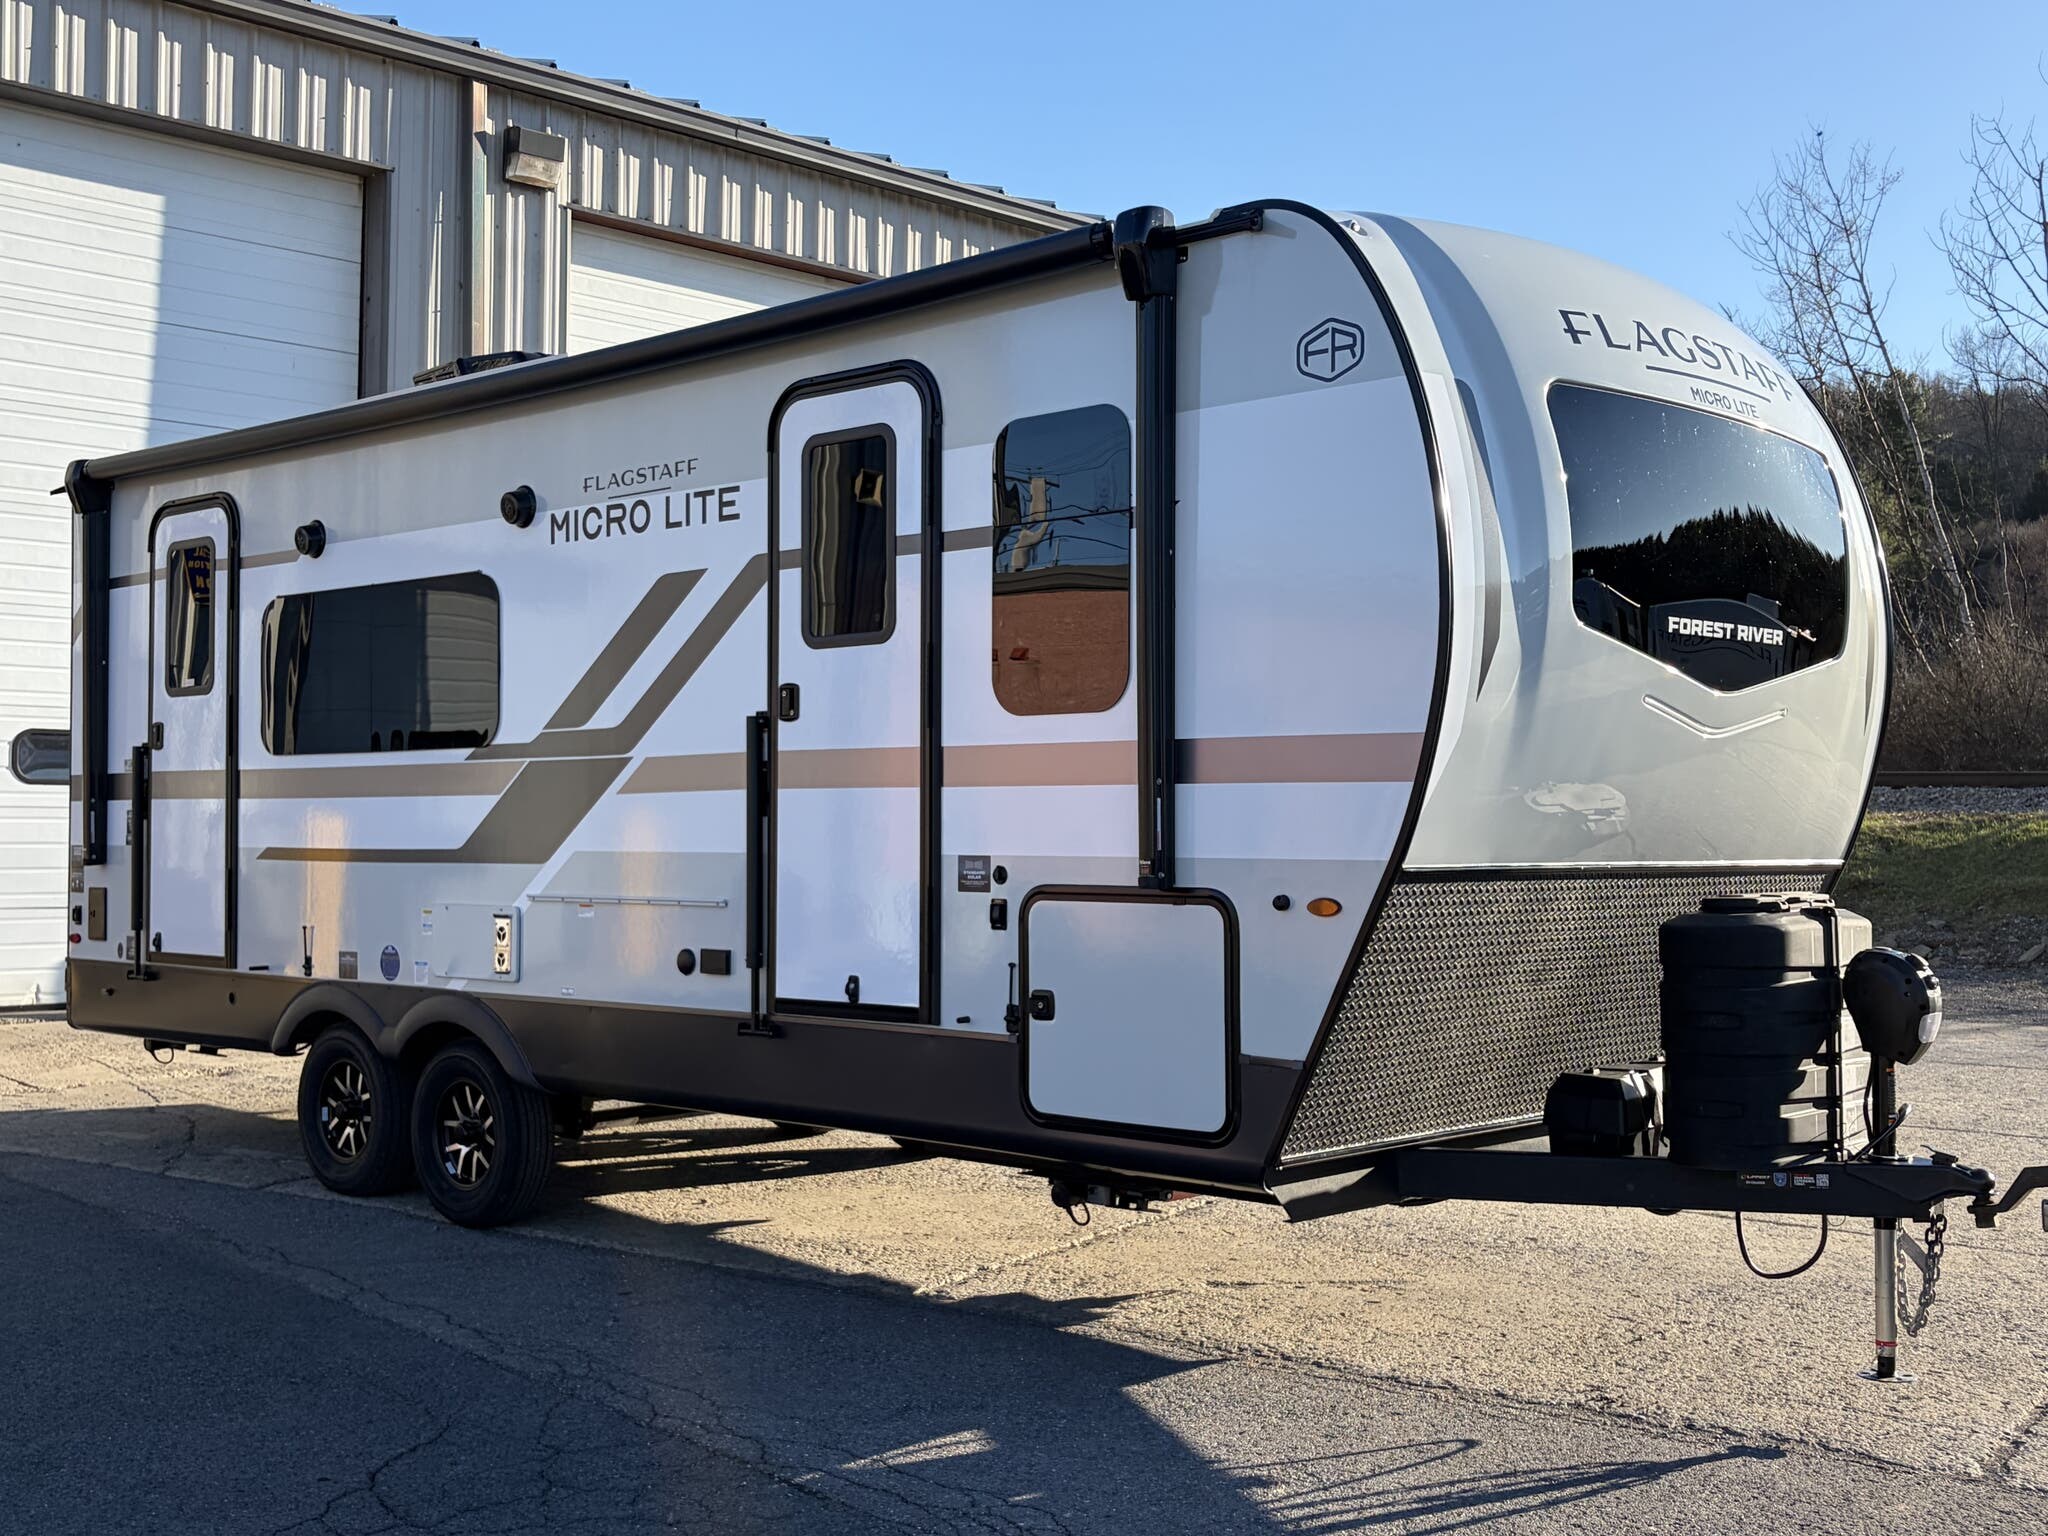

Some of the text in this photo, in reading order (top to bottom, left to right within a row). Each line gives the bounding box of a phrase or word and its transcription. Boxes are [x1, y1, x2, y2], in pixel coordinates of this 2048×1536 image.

[1558, 309, 1793, 401] FLAGSTAFF
[1690, 386, 1761, 419] MICRO LITE
[582, 458, 699, 493] FLAGSTAFF
[550, 485, 741, 545] MICRO LITE
[1667, 615, 1784, 646] FOREST RIVER
